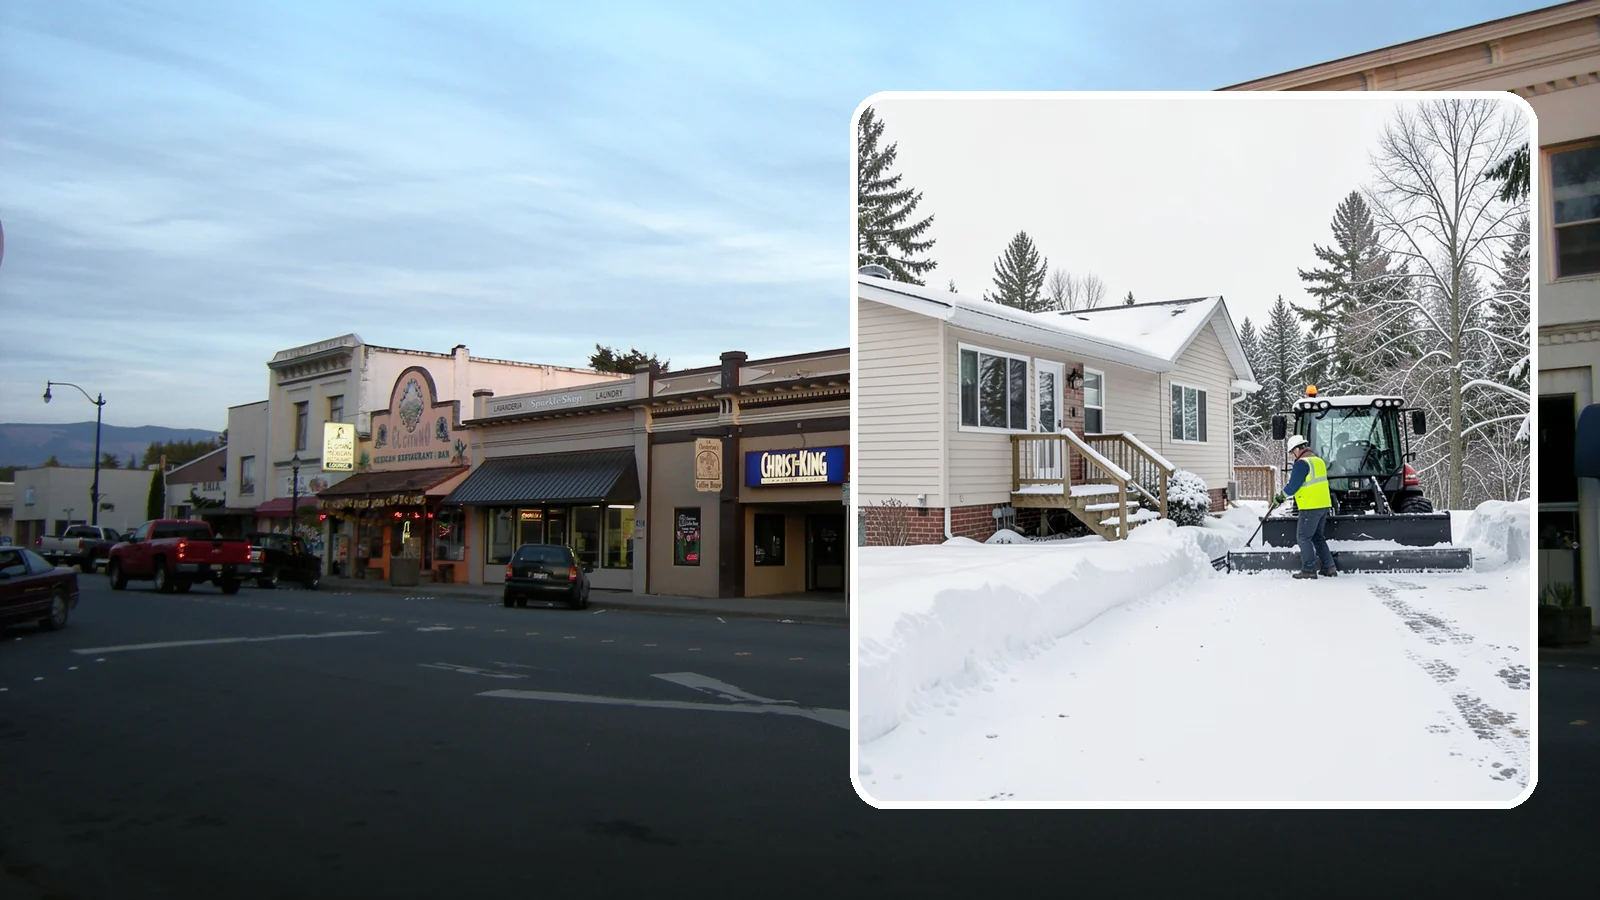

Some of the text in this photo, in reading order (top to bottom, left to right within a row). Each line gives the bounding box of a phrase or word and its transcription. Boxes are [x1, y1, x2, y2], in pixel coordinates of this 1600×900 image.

[531, 394, 582, 408] Sparkle Shop
[595, 389, 623, 400] LAUNDRY
[493, 402, 522, 412] LAVANDERIA
[373, 455, 396, 464] MEXICAN
[397, 451, 433, 462] RESTAURANT
[438, 450, 450, 458] BAR
[761, 452, 797, 478] CHRIST
[799, 450, 827, 476] KING
